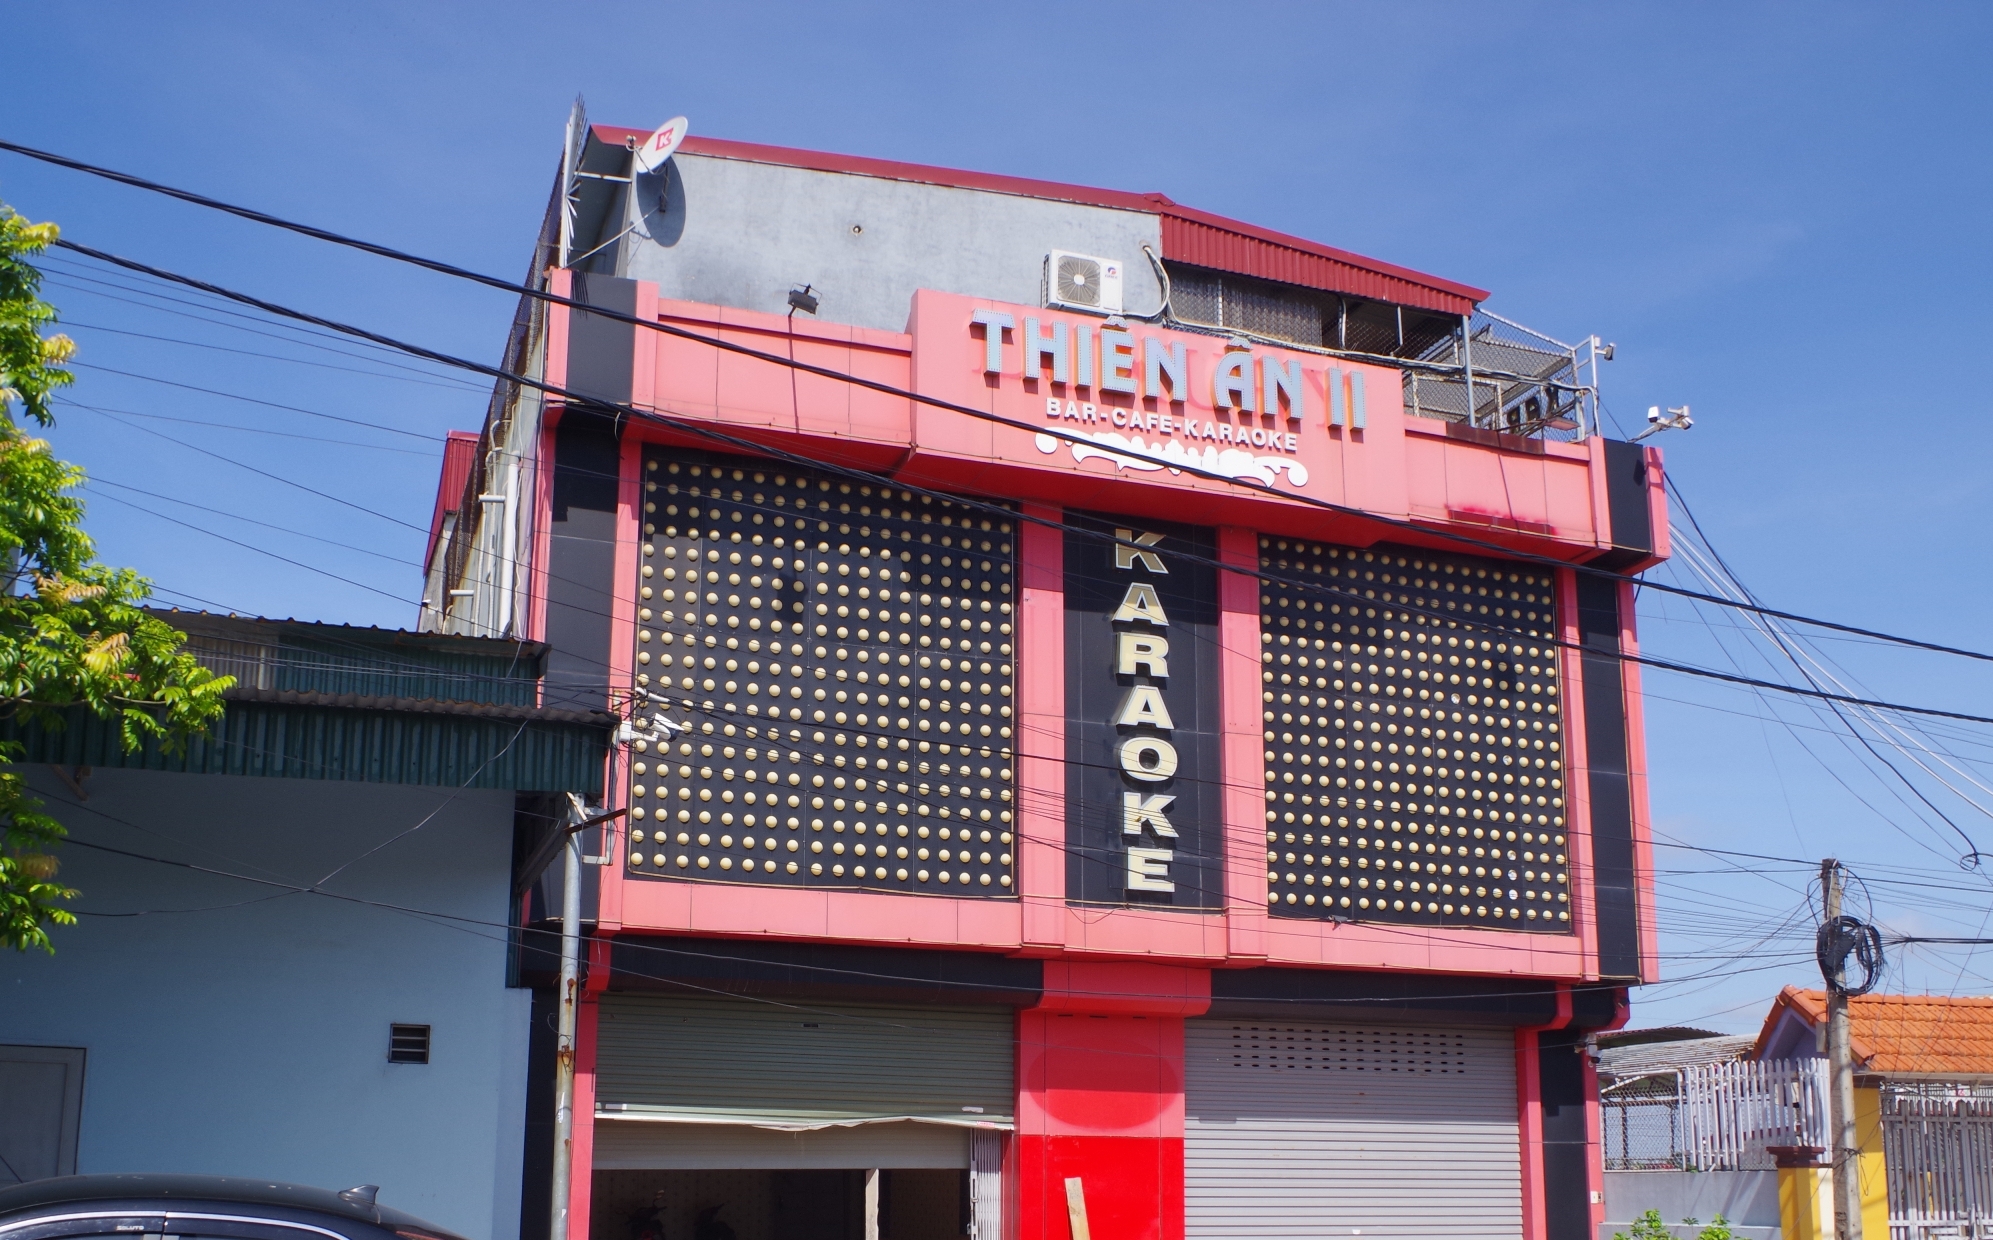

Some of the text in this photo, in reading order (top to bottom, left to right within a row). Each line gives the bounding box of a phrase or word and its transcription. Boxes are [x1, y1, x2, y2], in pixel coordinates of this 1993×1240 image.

[969, 308, 1367, 433] THIÊN ÂN II
[1112, 528, 1178, 893] KARAOKE
